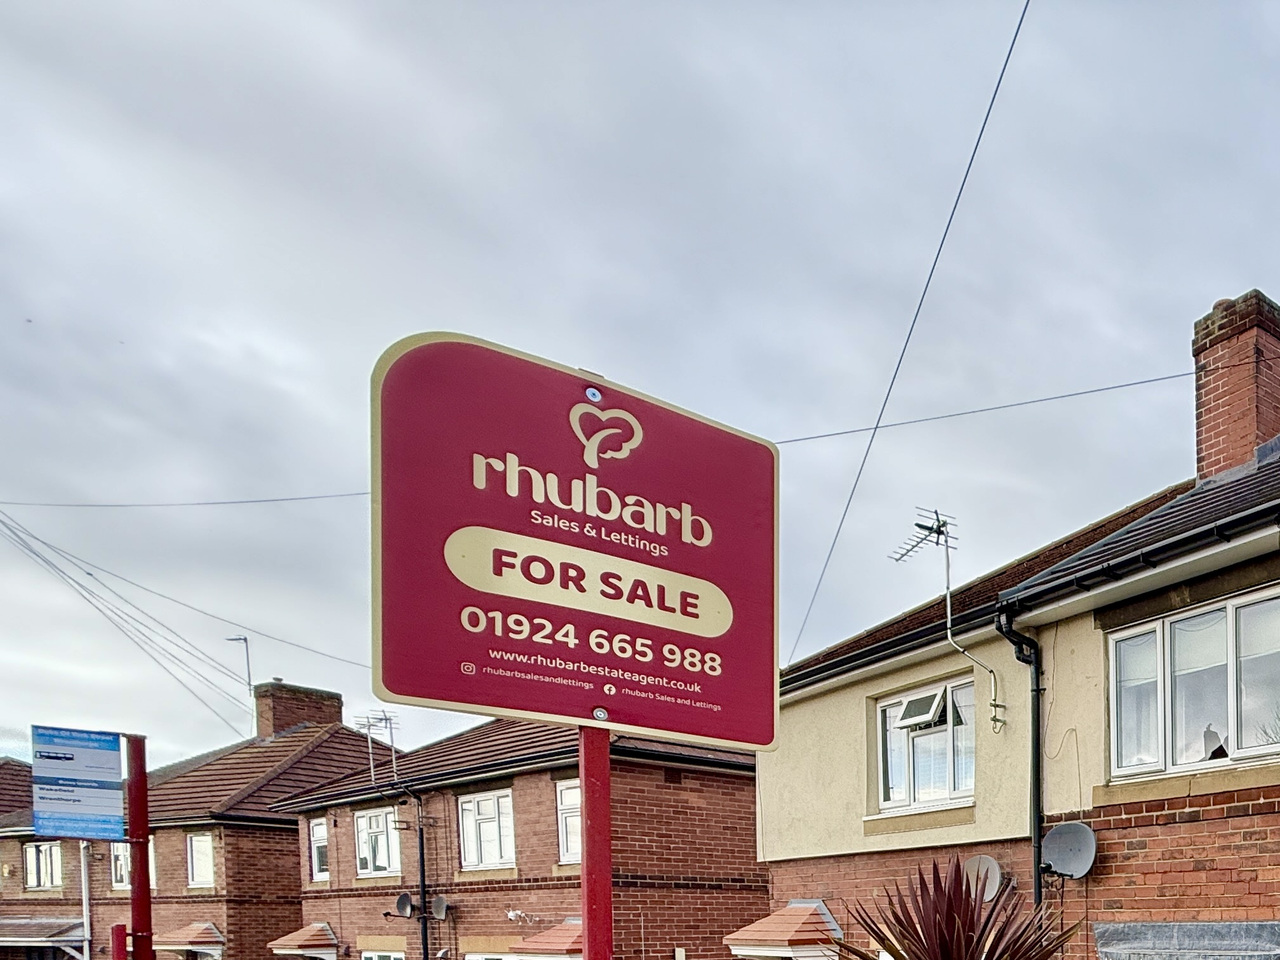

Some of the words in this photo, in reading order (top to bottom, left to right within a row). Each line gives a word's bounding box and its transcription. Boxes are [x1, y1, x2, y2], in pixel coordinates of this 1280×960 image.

[473, 453, 713, 547] rhubarb
[531, 511, 579, 533] Sales
[584, 523, 598, 538] &
[601, 527, 669, 557] Lettings
[492, 548, 587, 594] FOR
[599, 571, 700, 619] SALE
[460, 606, 579, 649] 01924
[588, 629, 654, 663] 665
[662, 643, 722, 677] 988
[482, 666, 594, 690] rhubarbsalesandlettings
[488, 649, 702, 693] www.rhubarbestateagent.co.uk
[621, 688, 654, 699] rhubarb
[655, 693, 676, 703] Sales
[676, 698, 691, 706] and
[691, 700, 722, 712] Lettings
